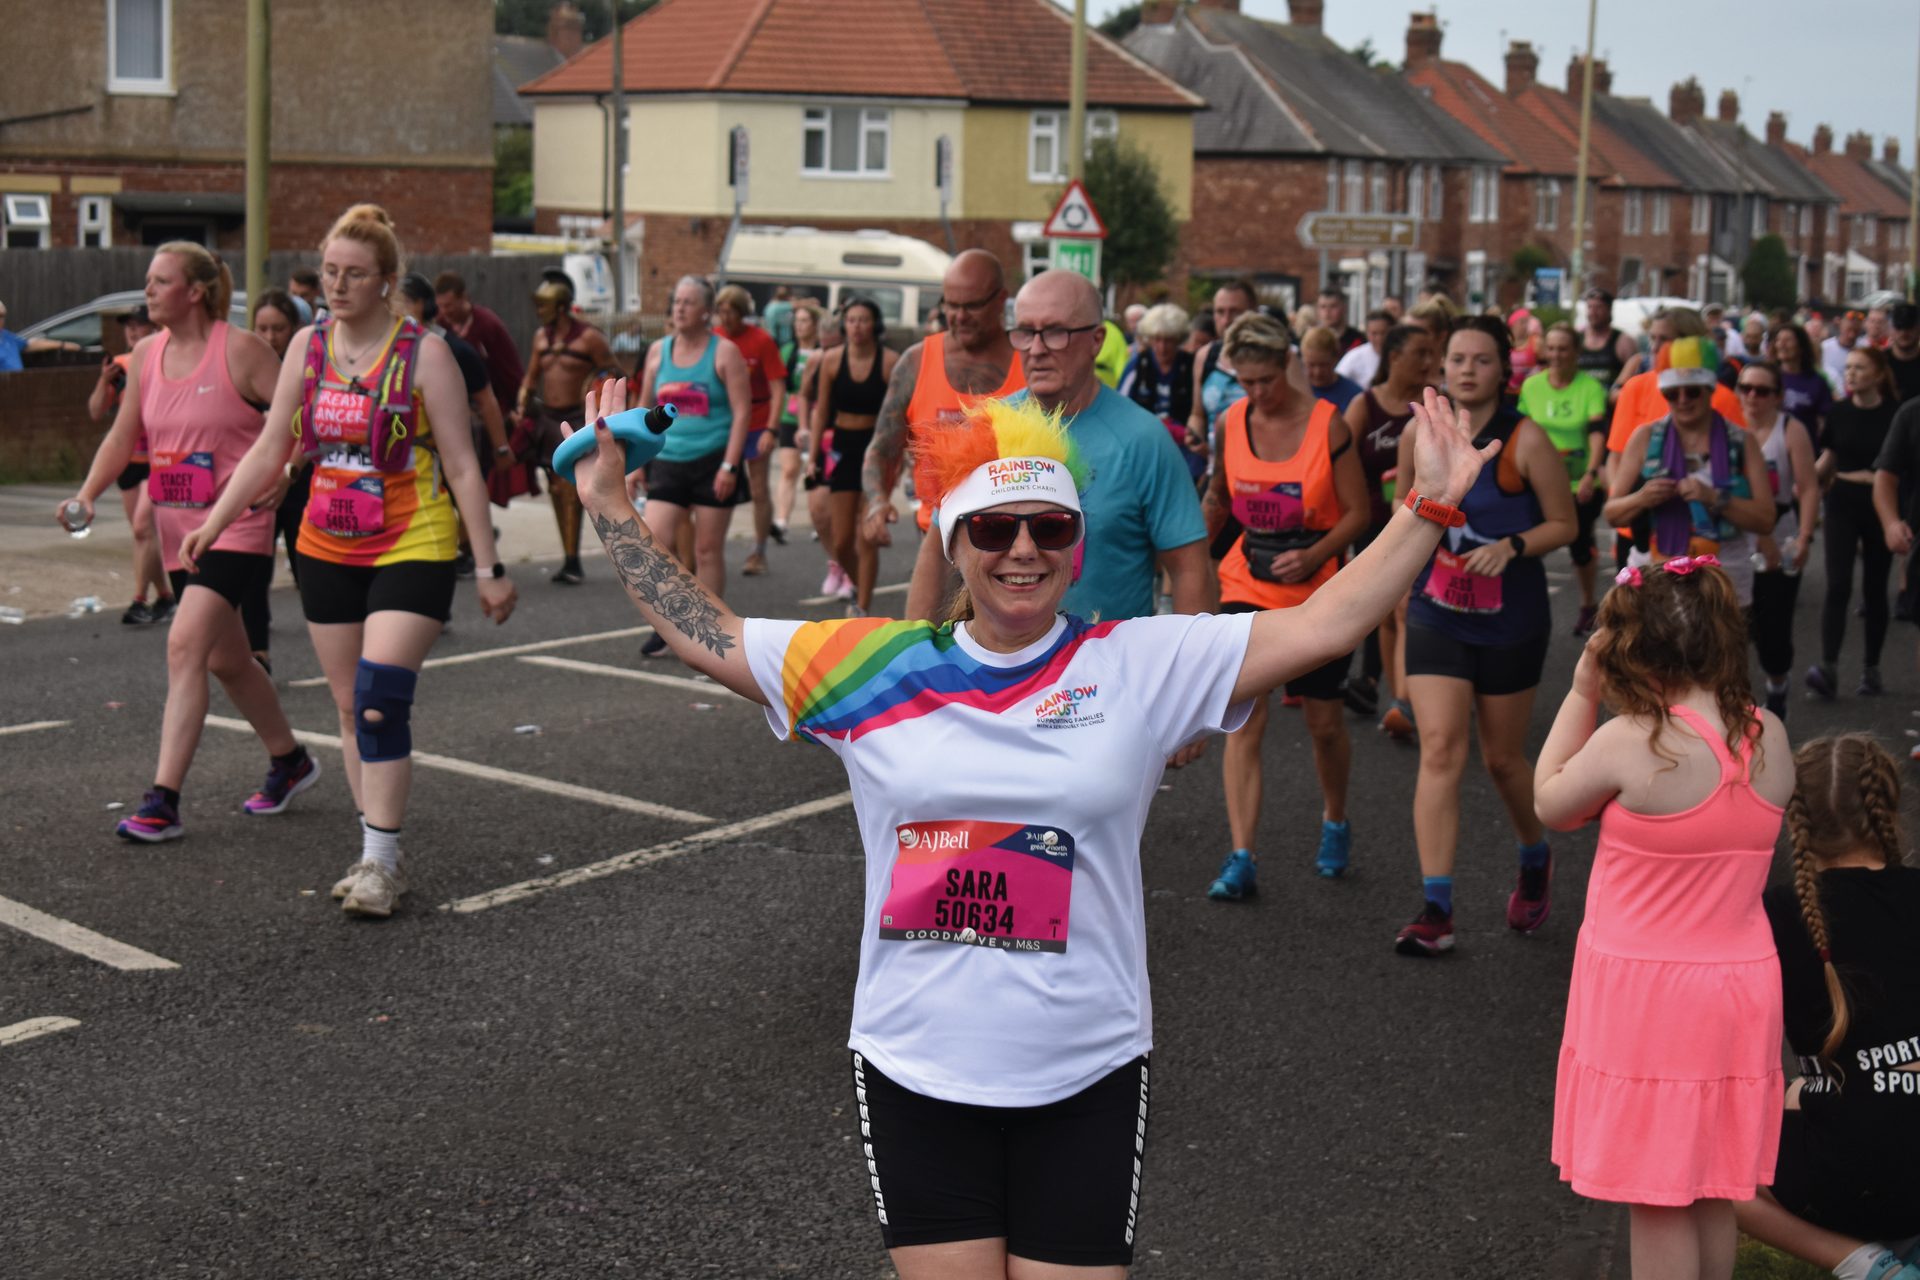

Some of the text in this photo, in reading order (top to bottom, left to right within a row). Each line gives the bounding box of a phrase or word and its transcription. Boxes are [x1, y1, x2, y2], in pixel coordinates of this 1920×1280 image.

[317, 389, 365, 408] REAST
[315, 406, 369, 423] ANCER
[988, 460, 1055, 477] RAINBOW
[990, 472, 1041, 487] TRUST
[1032, 484, 1057, 494] CHARITY
[991, 484, 1030, 496] CHILDREN'S
[1035, 684, 1097, 716] RAINBOW
[1074, 712, 1104, 722] FAMILIES
[1088, 718, 1105, 726] CHILD
[945, 868, 1008, 901] SARA
[935, 900, 1014, 934] 50634
[905, 929, 1040, 951] GOODMVE by M&S
[1856, 1036, 1920, 1071] SPORT
[853, 1052, 872, 1138] GUESS
[1136, 1065, 1148, 1155] GUESS
